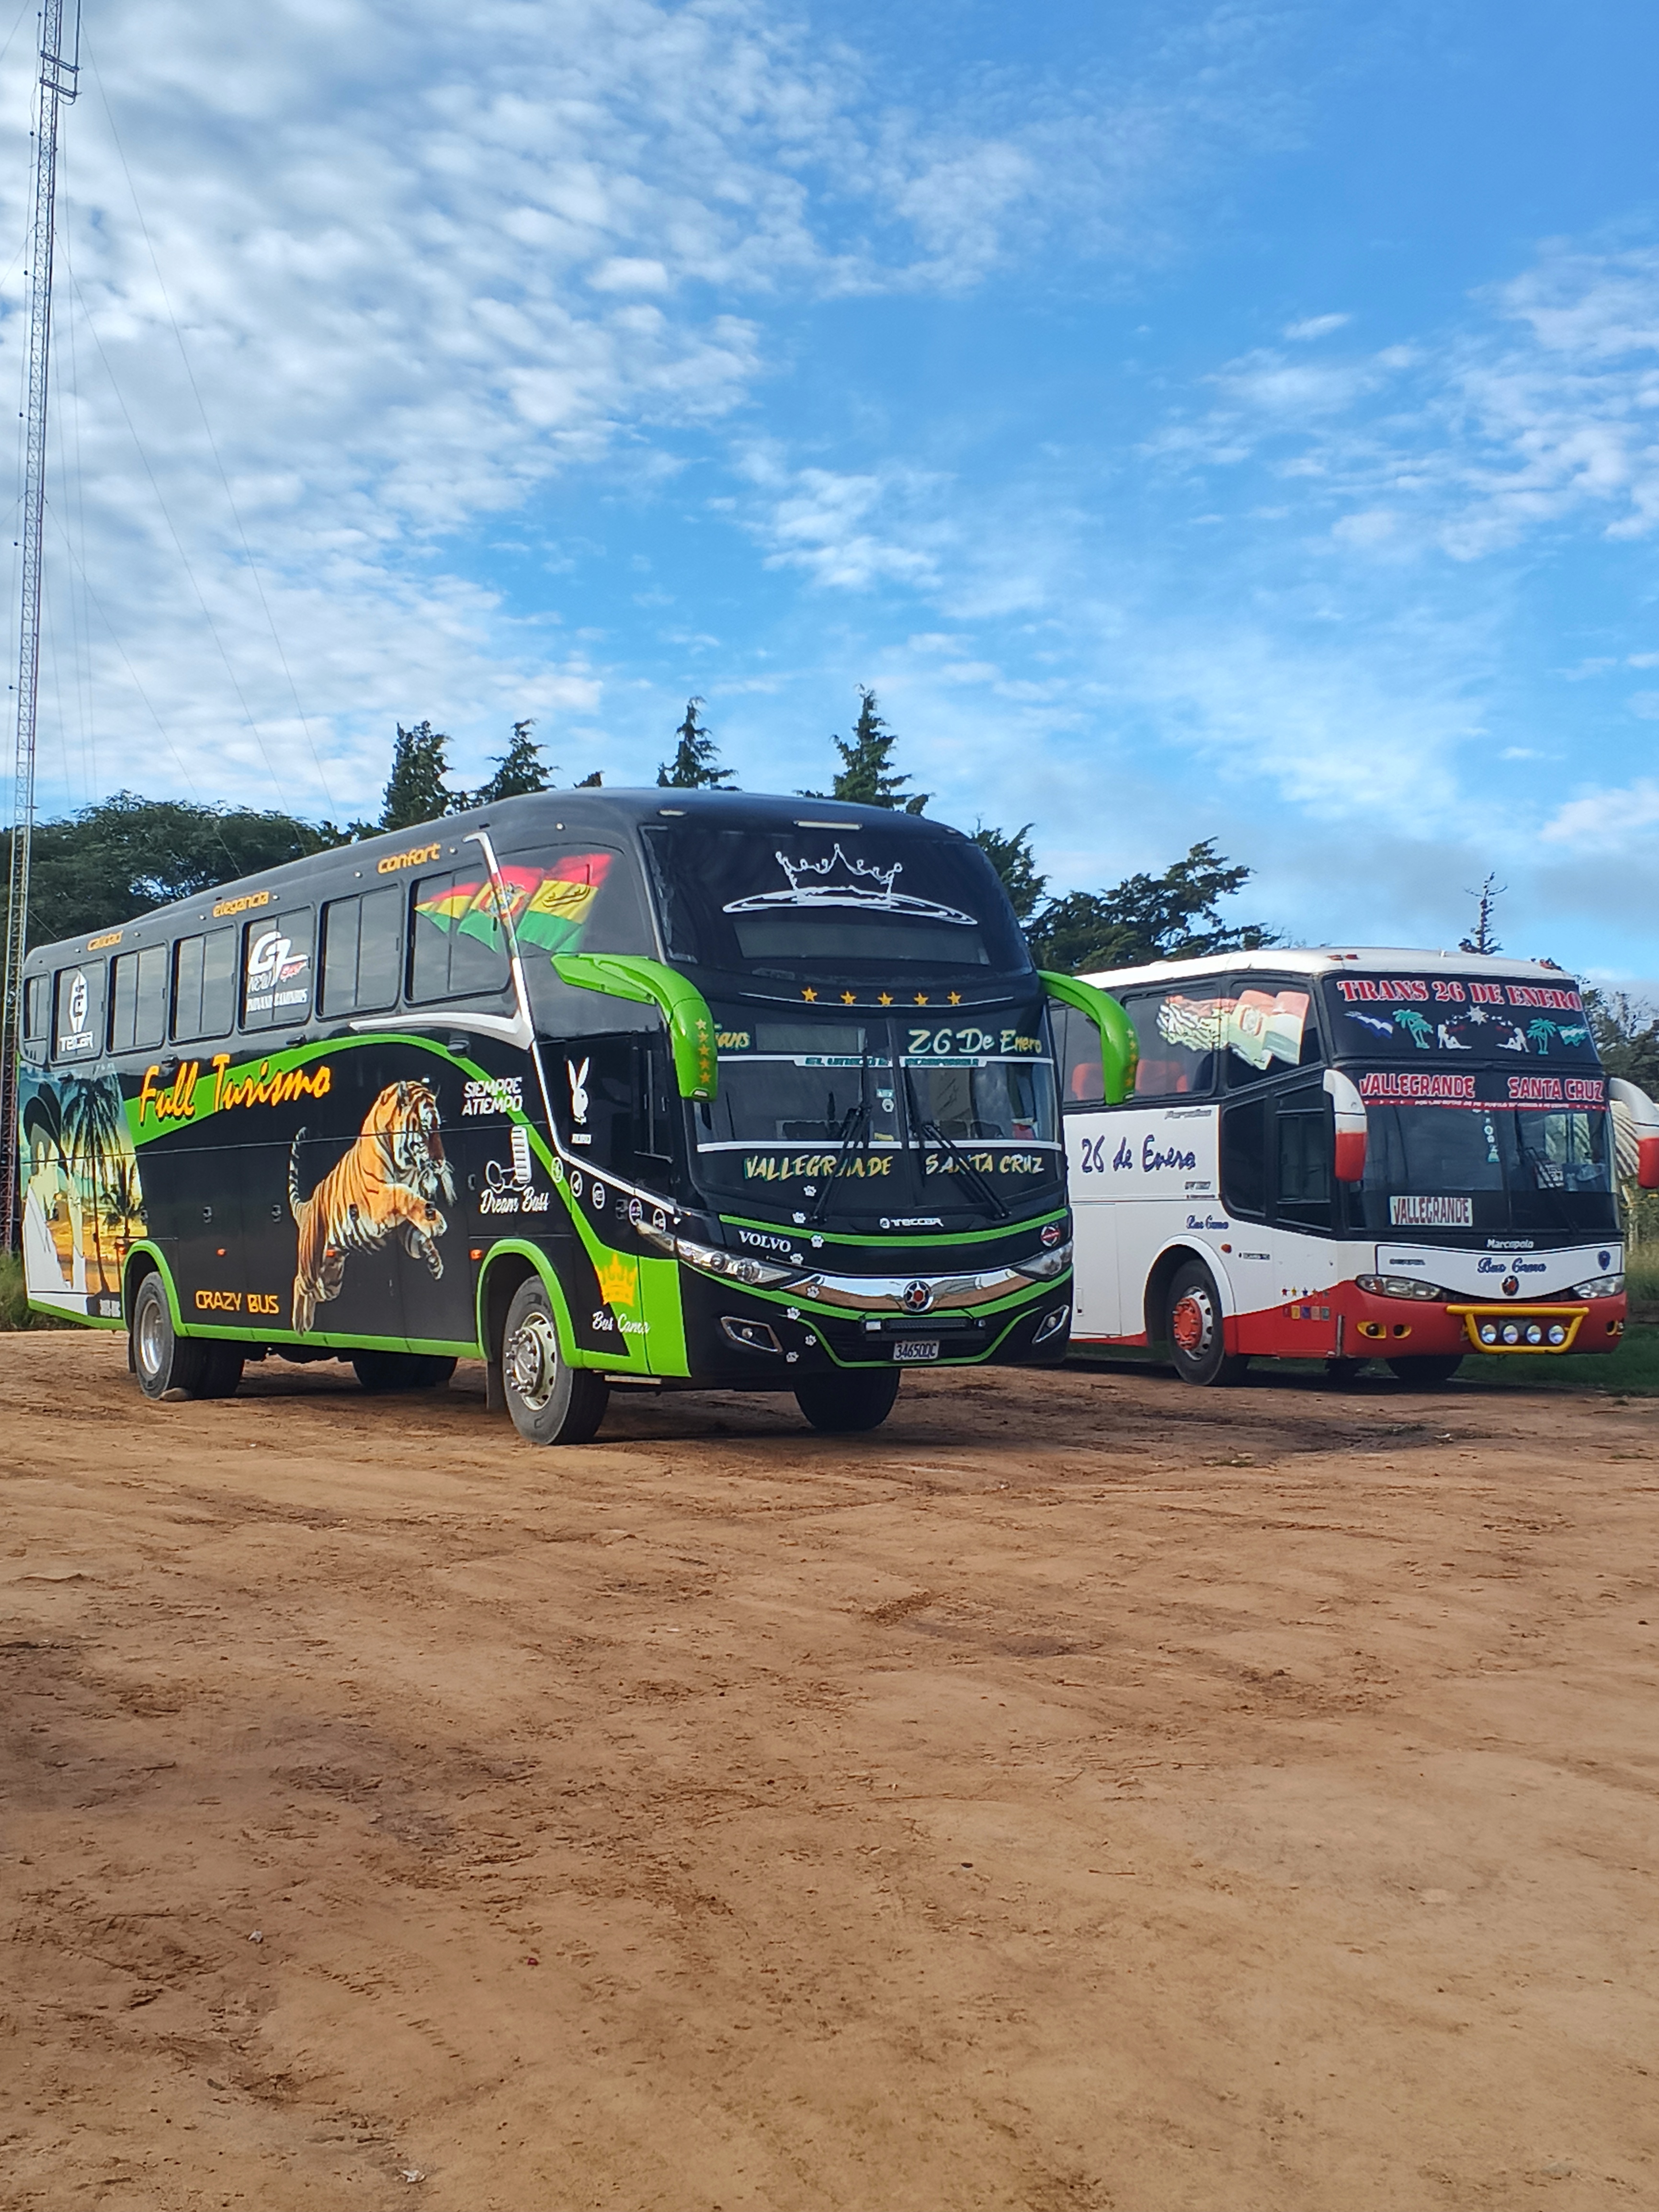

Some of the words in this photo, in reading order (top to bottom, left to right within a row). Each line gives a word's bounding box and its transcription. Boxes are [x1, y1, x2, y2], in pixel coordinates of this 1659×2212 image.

[377, 843, 441, 874] confort
[1337, 981, 1429, 1002] TRANS
[1432, 981, 1466, 1002] 26
[1468, 983, 1505, 1005] DE
[1506, 985, 1582, 1012] ENERO
[715, 1023, 750, 1049] ans
[956, 1028, 995, 1053] De
[1000, 1029, 1042, 1053] Enero
[139, 1063, 195, 1123] Full
[212, 1053, 331, 1113] Turismo
[463, 1076, 523, 1098] SIEMPRE
[1360, 1073, 1476, 1098] VALLEGRANDE
[1508, 1077, 1562, 1100] SANTA
[1564, 1079, 1604, 1102] CRUZ
[999, 1153, 1045, 1174] CRUZ
[1081, 1134, 1105, 1174] 26
[1113, 1136, 1133, 1172] de
[1142, 1134, 1196, 1173] Enero
[1394, 1197, 1469, 1224] VALLEGRANDE
[738, 1230, 792, 1253] VOLVO
[1486, 1239, 1534, 1249] Marcopolo
[1477, 1257, 1506, 1273] Bus
[195, 1290, 242, 1311] CRAZY
[247, 1294, 280, 1314] BUS
[592, 1311, 614, 1331] Bus
